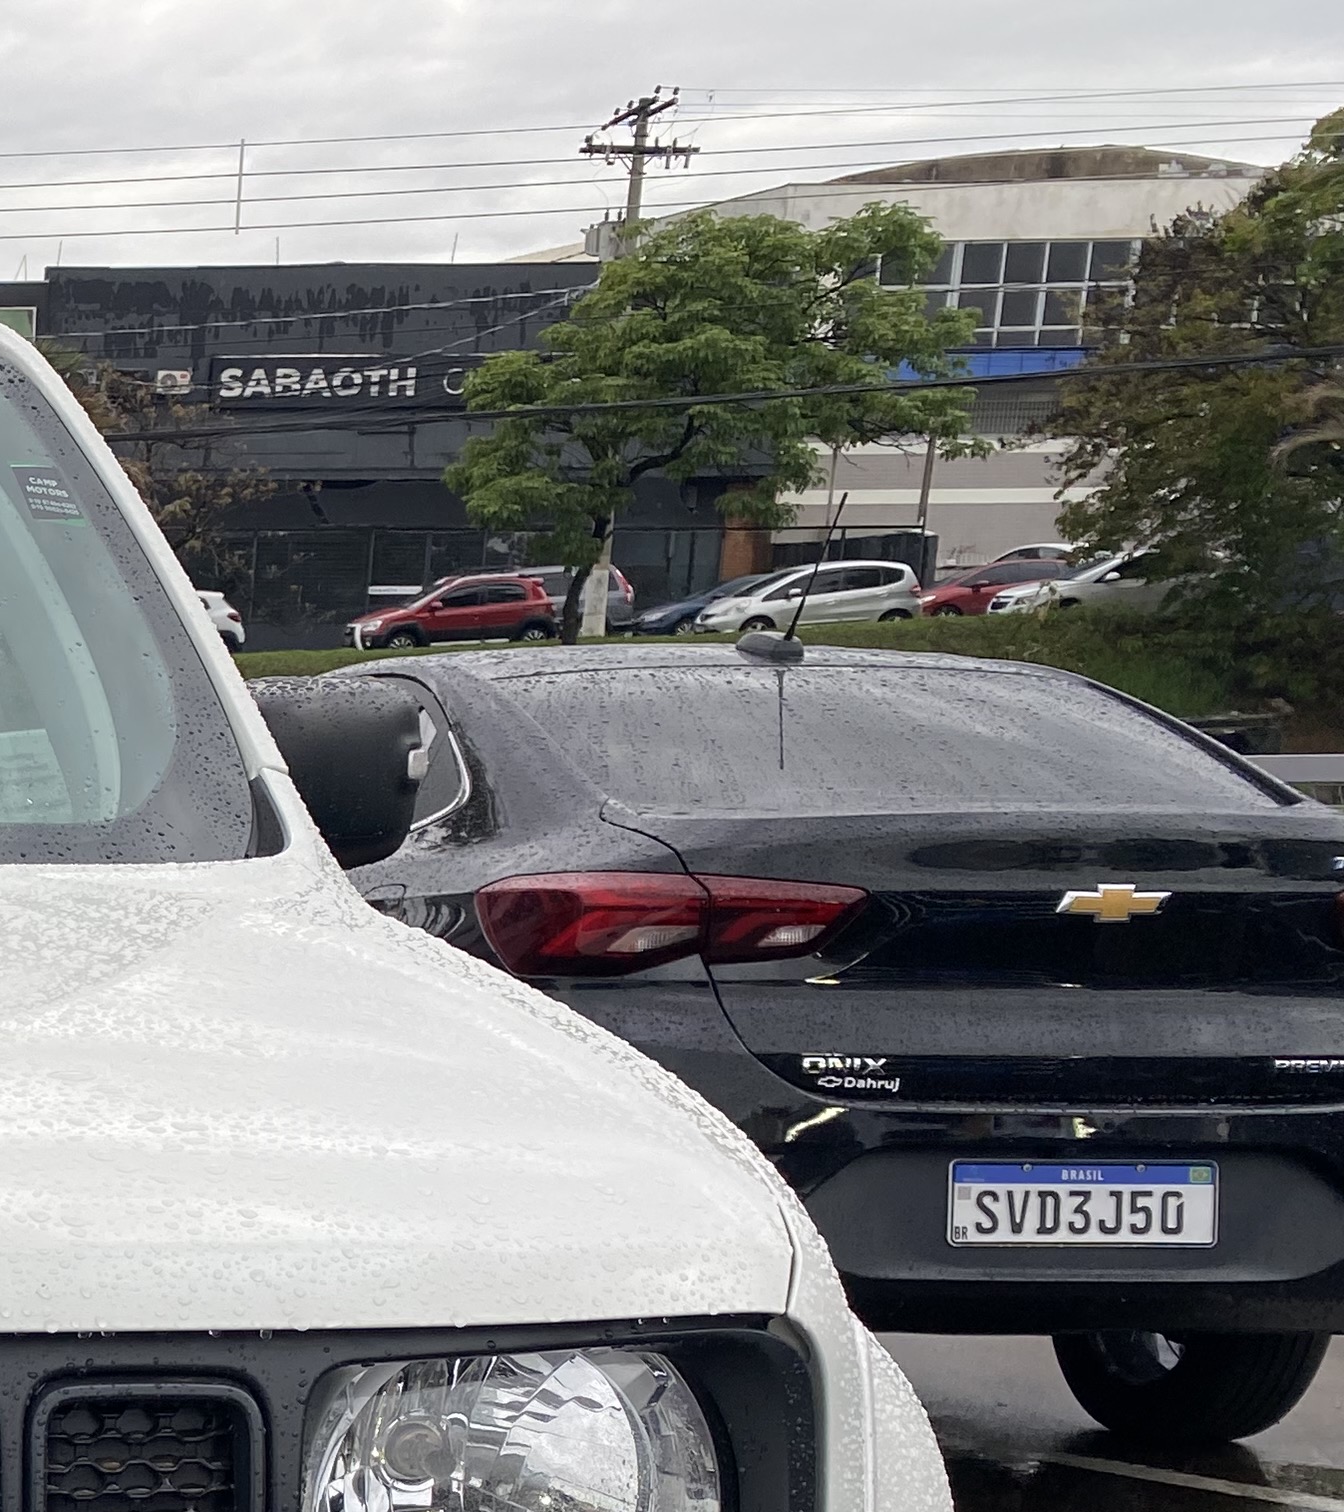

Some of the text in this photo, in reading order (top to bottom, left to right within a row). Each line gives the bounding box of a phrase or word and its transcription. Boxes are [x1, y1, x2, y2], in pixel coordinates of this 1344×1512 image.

[219, 367, 417, 398] SABAOTH
[28, 477, 58, 487] CAMP
[25, 485, 69, 498] MOTORS
[801, 1053, 888, 1075] ONIX
[843, 1076, 901, 1093] Dahruj
[1061, 1169, 1104, 1181] BRASIL
[975, 1190, 1185, 1235] SVD3J50
[954, 1226, 968, 1240] BR
